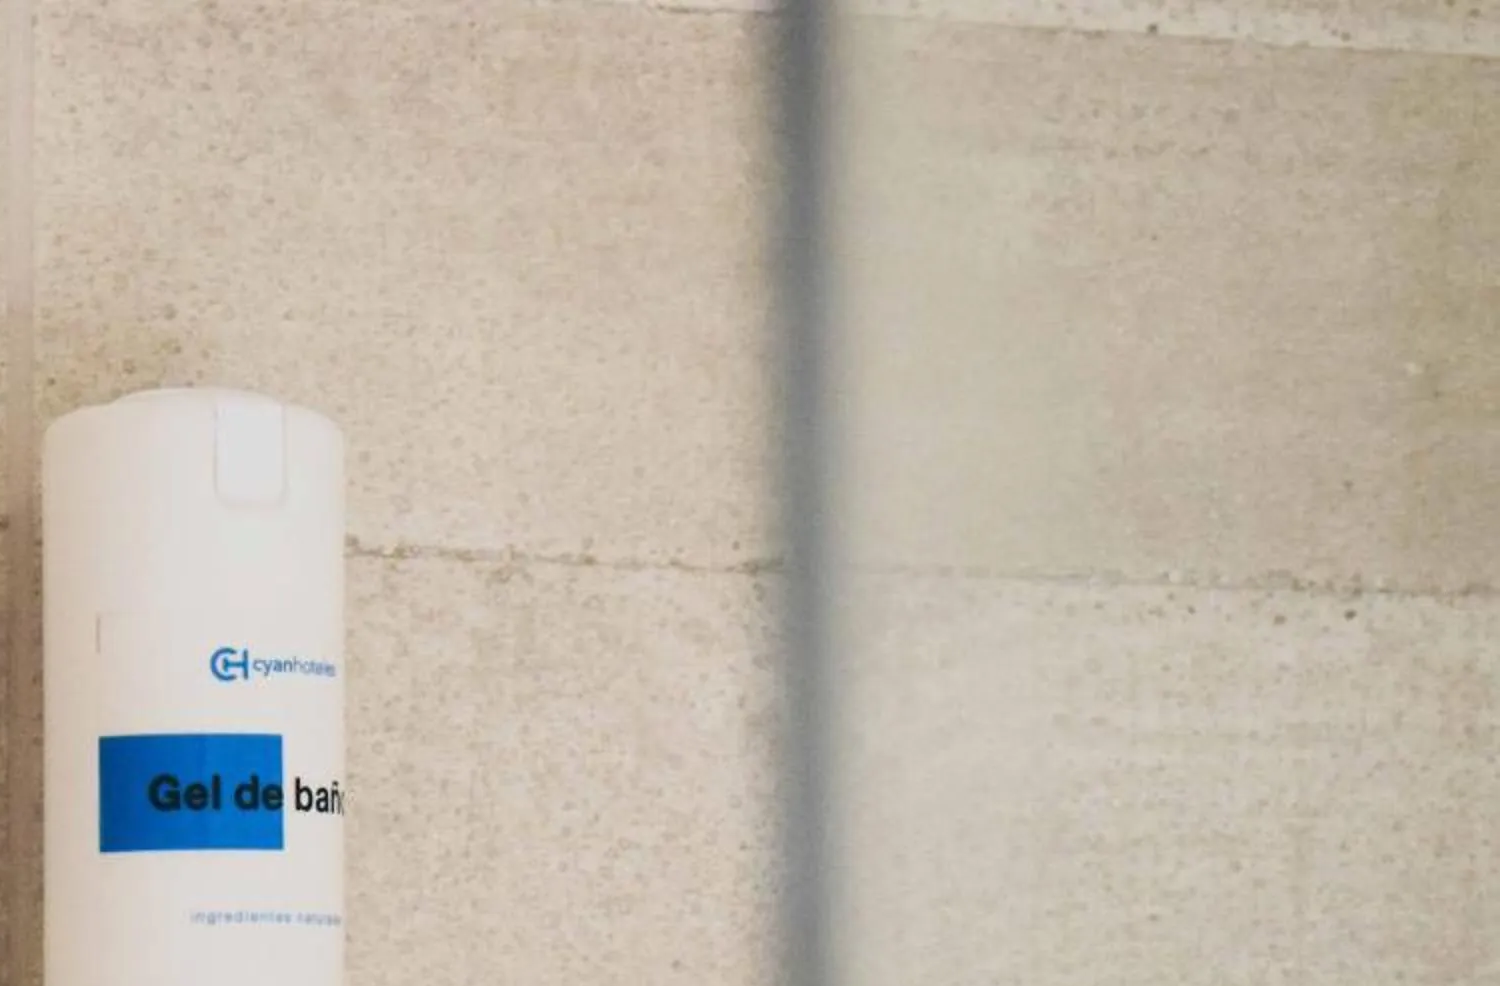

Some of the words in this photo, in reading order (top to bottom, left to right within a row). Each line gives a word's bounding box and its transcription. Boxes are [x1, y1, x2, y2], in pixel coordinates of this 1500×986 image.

[148, 772, 222, 811] Gel
[234, 773, 284, 811] de
[190, 910, 292, 926] ingredientes
